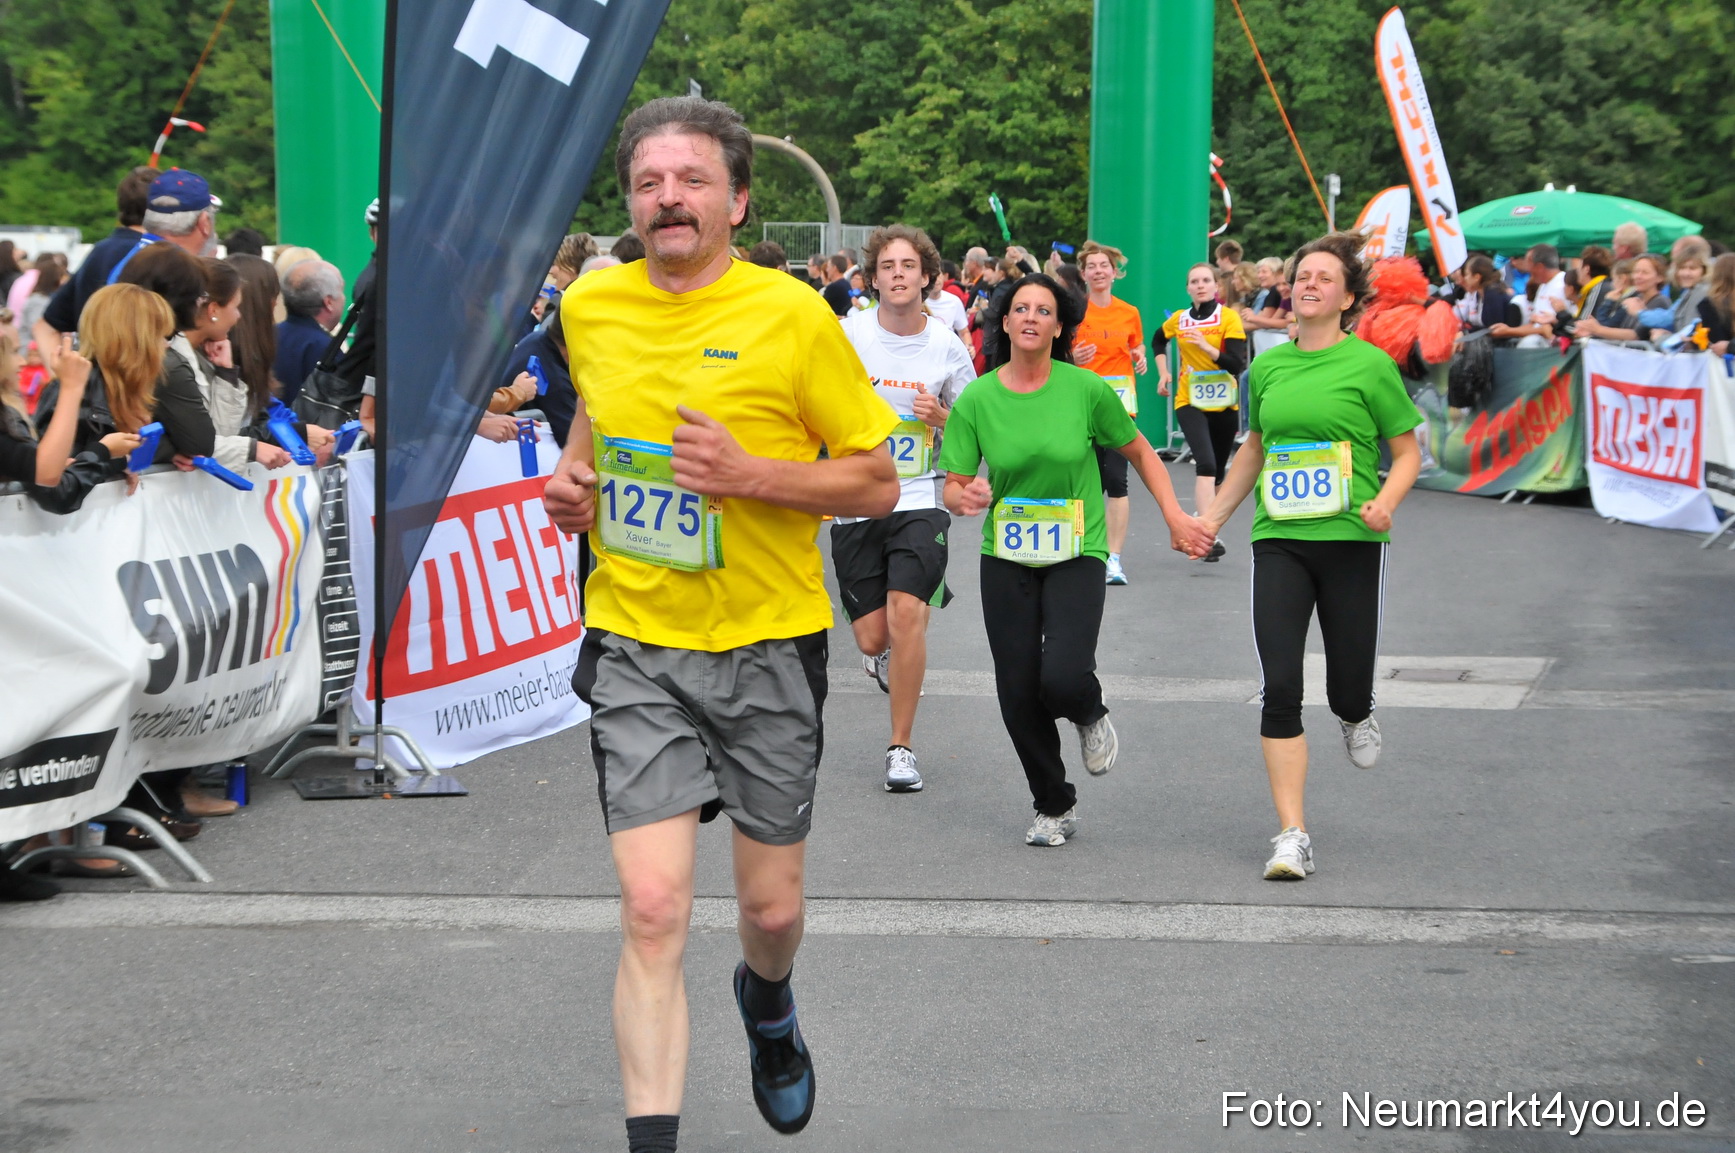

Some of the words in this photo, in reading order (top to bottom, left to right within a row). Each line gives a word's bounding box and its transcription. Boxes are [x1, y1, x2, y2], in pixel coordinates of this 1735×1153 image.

[703, 348, 739, 360] KANN
[1194, 383, 1227, 400] 392
[1595, 386, 1695, 480] MEIER
[1271, 468, 1332, 501] 808
[601, 478, 700, 537] 1275
[1279, 501, 1310, 509] Susanne
[626, 530, 653, 545] Xaver
[1004, 522, 1060, 551] 811
[116, 542, 269, 695] swn
[19, 754, 100, 787] verbinden
